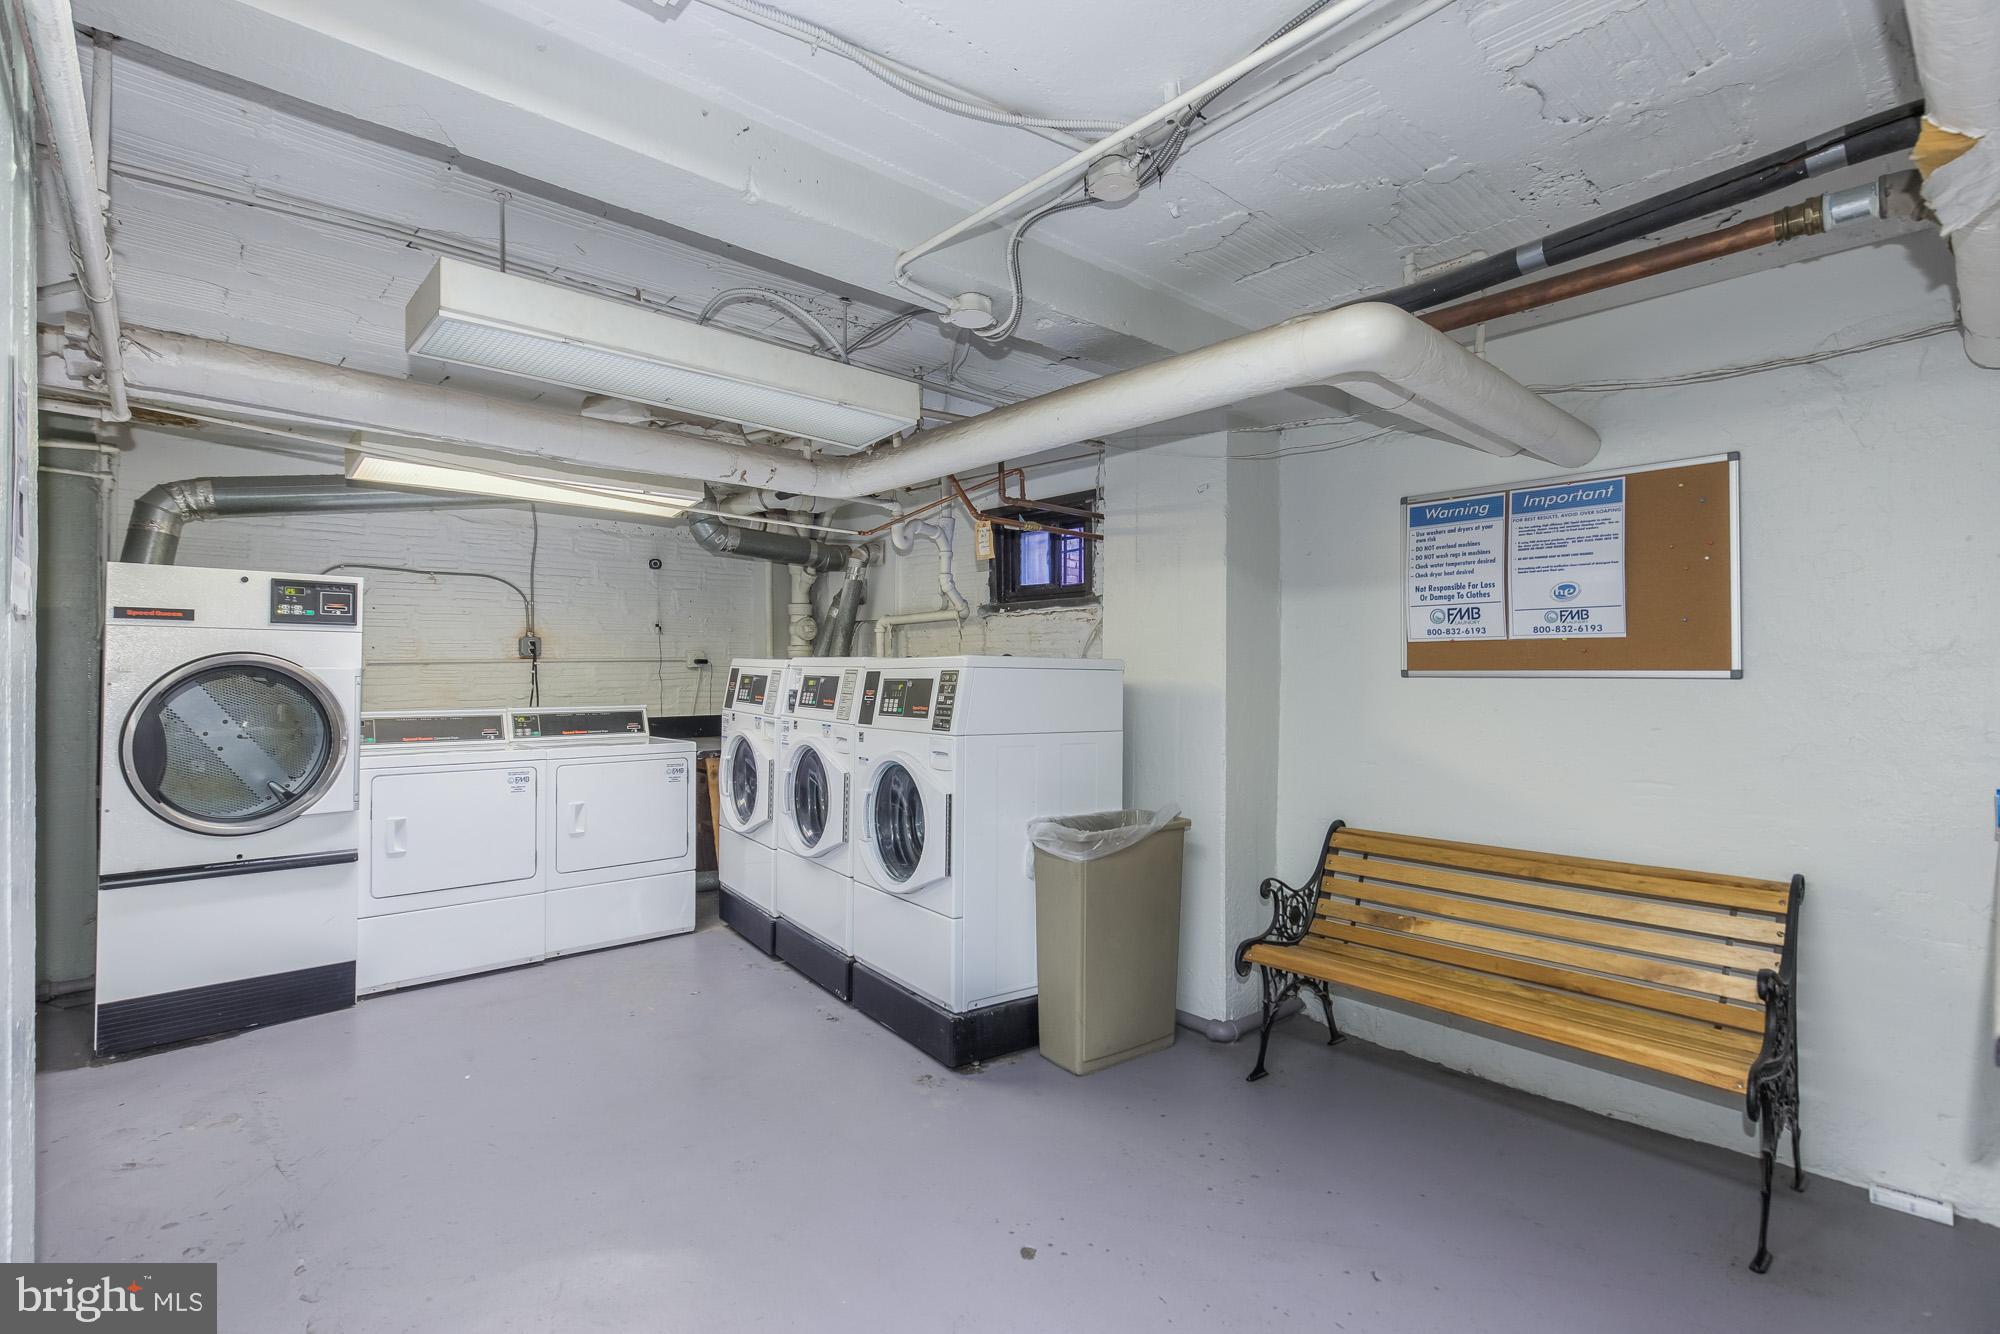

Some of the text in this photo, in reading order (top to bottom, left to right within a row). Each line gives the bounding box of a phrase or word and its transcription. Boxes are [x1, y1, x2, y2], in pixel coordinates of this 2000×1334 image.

[1523, 485, 1614, 508] Important
[1425, 503, 1489, 519] Warning
[1445, 559, 1475, 567] temperature
[1429, 583, 1466, 593] Responsible
[1430, 593, 1455, 601] Damage
[1447, 607, 1480, 624] FMB
[1560, 609, 1589, 623] FMB
[1427, 627, 1486, 636] 800-832-6193
[1533, 625, 1603, 633] 800-832-6193
